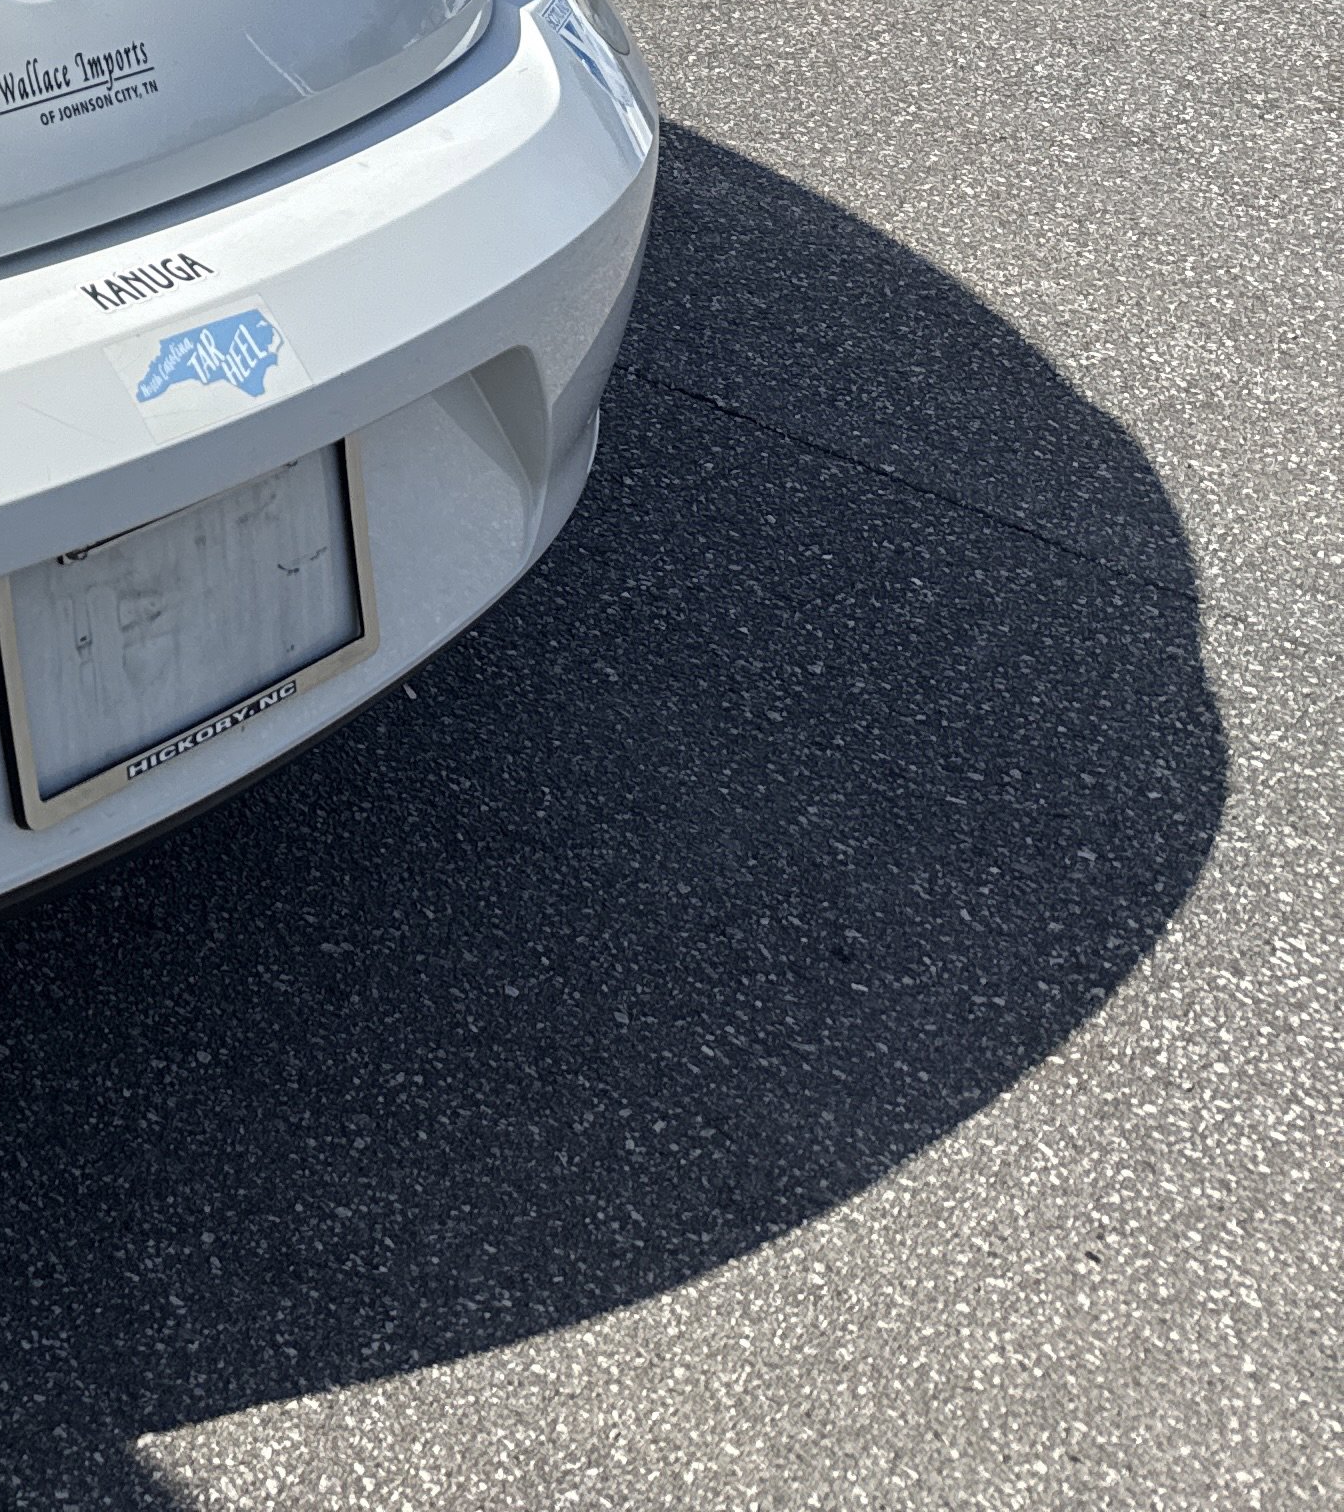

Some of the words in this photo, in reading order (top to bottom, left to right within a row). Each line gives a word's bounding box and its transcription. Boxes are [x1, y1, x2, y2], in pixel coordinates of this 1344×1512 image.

[74, 39, 149, 92] Imports
[40, 110, 57, 126] OF
[58, 92, 114, 122] JOHNSON
[114, 84, 144, 104] CITY,
[142, 79, 159, 95] TN
[79, 252, 215, 311] KANUGA
[187, 328, 226, 384] TAR
[221, 323, 268, 386] HEEL
[259, 681, 296, 710] NC
